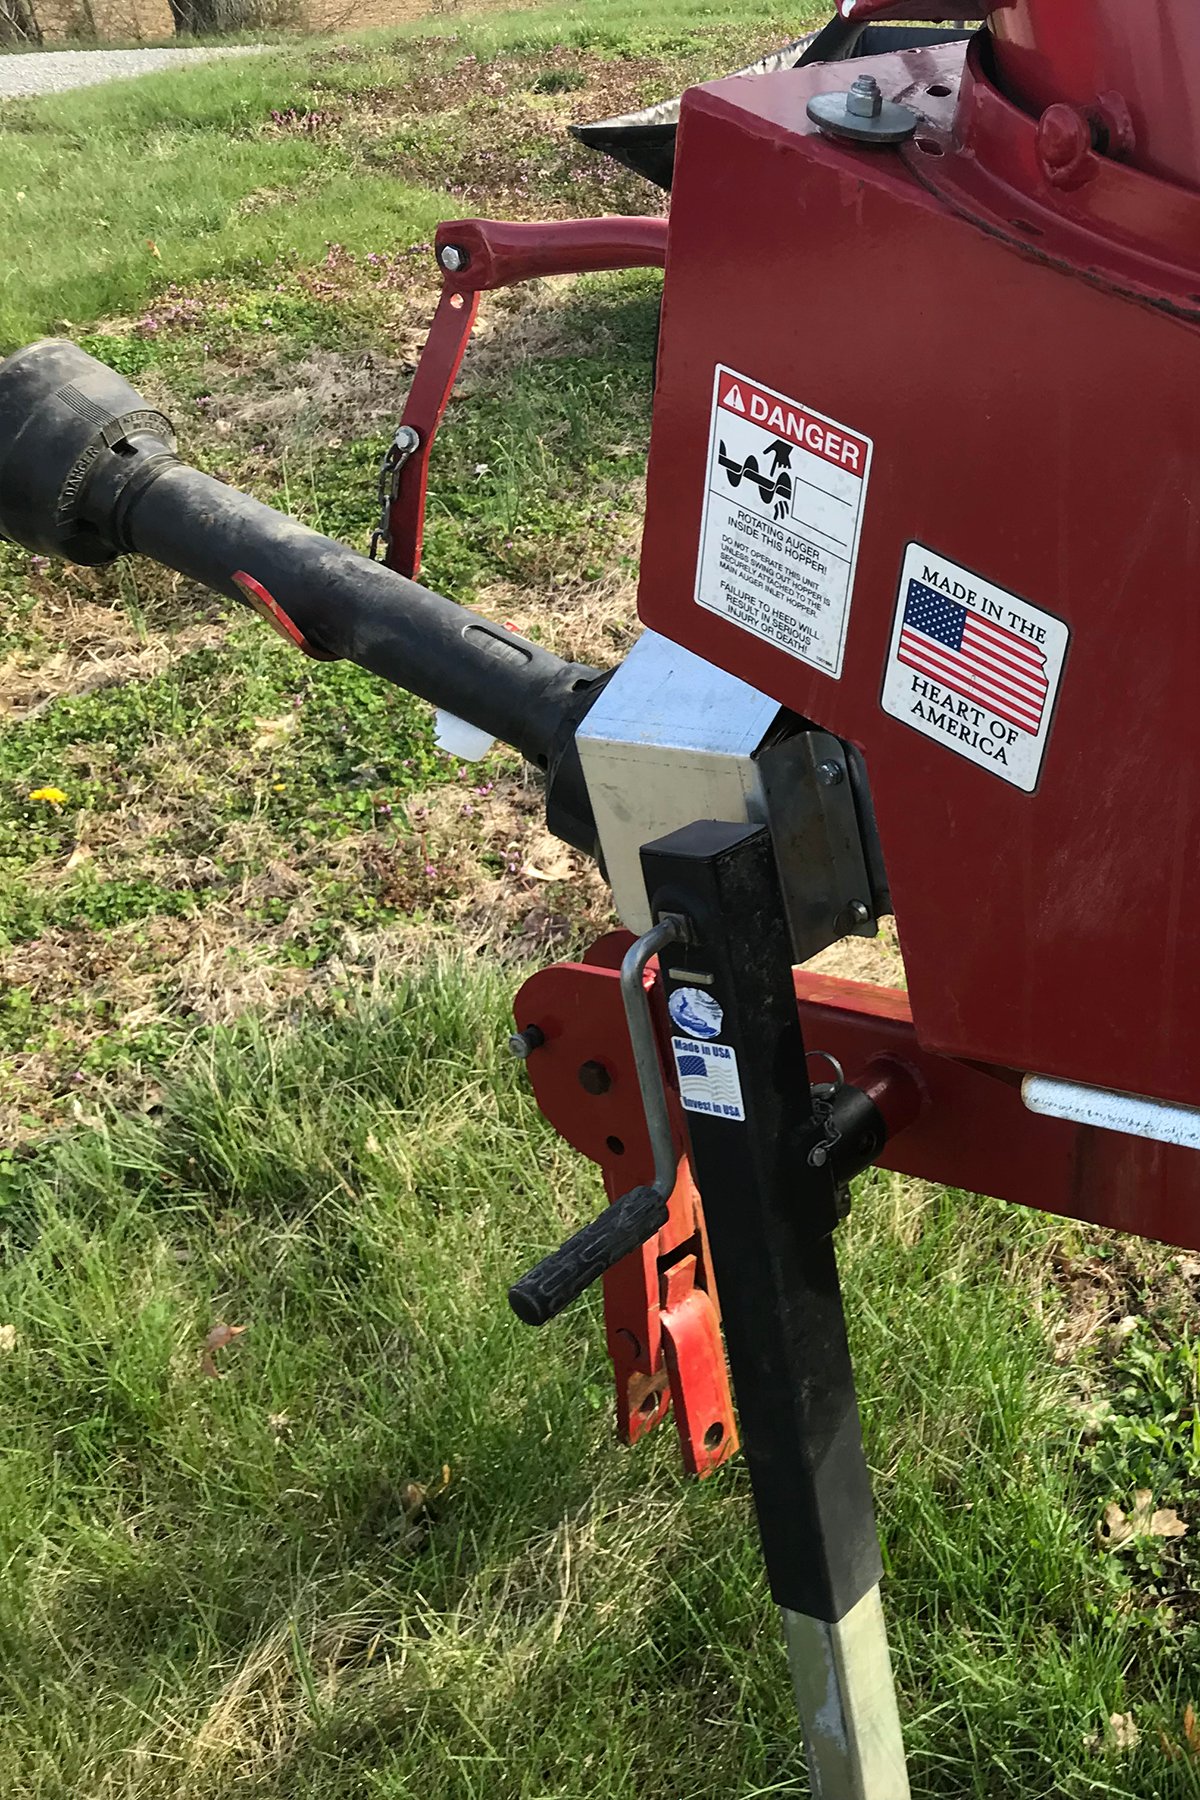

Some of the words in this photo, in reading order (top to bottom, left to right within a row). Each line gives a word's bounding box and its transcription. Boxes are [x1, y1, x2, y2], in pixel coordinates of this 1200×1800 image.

[750, 394, 860, 469] DANGER
[65, 446, 99, 496] DANGER
[722, 534, 732, 544] DO
[734, 541, 748, 553] NOT
[751, 549, 782, 571] OPERATE
[785, 567, 800, 580] THIS
[802, 577, 818, 590] UNIT
[728, 516, 758, 539] INSIDE
[761, 534, 782, 551] THIS
[785, 546, 827, 575] HOPPER!
[738, 510, 783, 541] ROTATING
[786, 535, 819, 559] AUGER
[720, 561, 737, 575] MAIN
[739, 571, 763, 589] AUGER
[765, 585, 783, 600] INLET
[720, 552, 756, 576] SECURELY
[758, 572, 794, 596] ATTACHED
[796, 592, 806, 602] TO
[808, 599, 821, 610] THE
[721, 543, 748, 562] UNLESS
[751, 559, 773, 576] SWING
[776, 572, 789, 584] OUT
[792, 581, 821, 601] HOPPER
[823, 597, 830, 606] IS
[720, 580, 756, 605] FAILURE
[758, 601, 770, 613] TO
[772, 608, 796, 627] HEED
[798, 622, 820, 639] WILL
[726, 593, 758, 617] RESULT
[762, 612, 769, 623] IN
[772, 618, 811, 645] SERIOUS
[728, 605, 758, 627] INJURY
[761, 622, 773, 635] OR
[776, 631, 807, 653] DEATH!
[921, 565, 976, 607] MADE
[980, 597, 1004, 620] IN
[1007, 611, 1047, 644] THE
[910, 700, 1009, 766] AMERICA
[911, 675, 985, 727] HEART
[989, 721, 1019, 746] OF
[674, 1039, 700, 1053] Made
[701, 1044, 711, 1056] in
[711, 1046, 732, 1060] USA
[683, 1096, 712, 1112] Invest
[712, 1102, 722, 1114] in
[722, 1104, 742, 1118] USA
